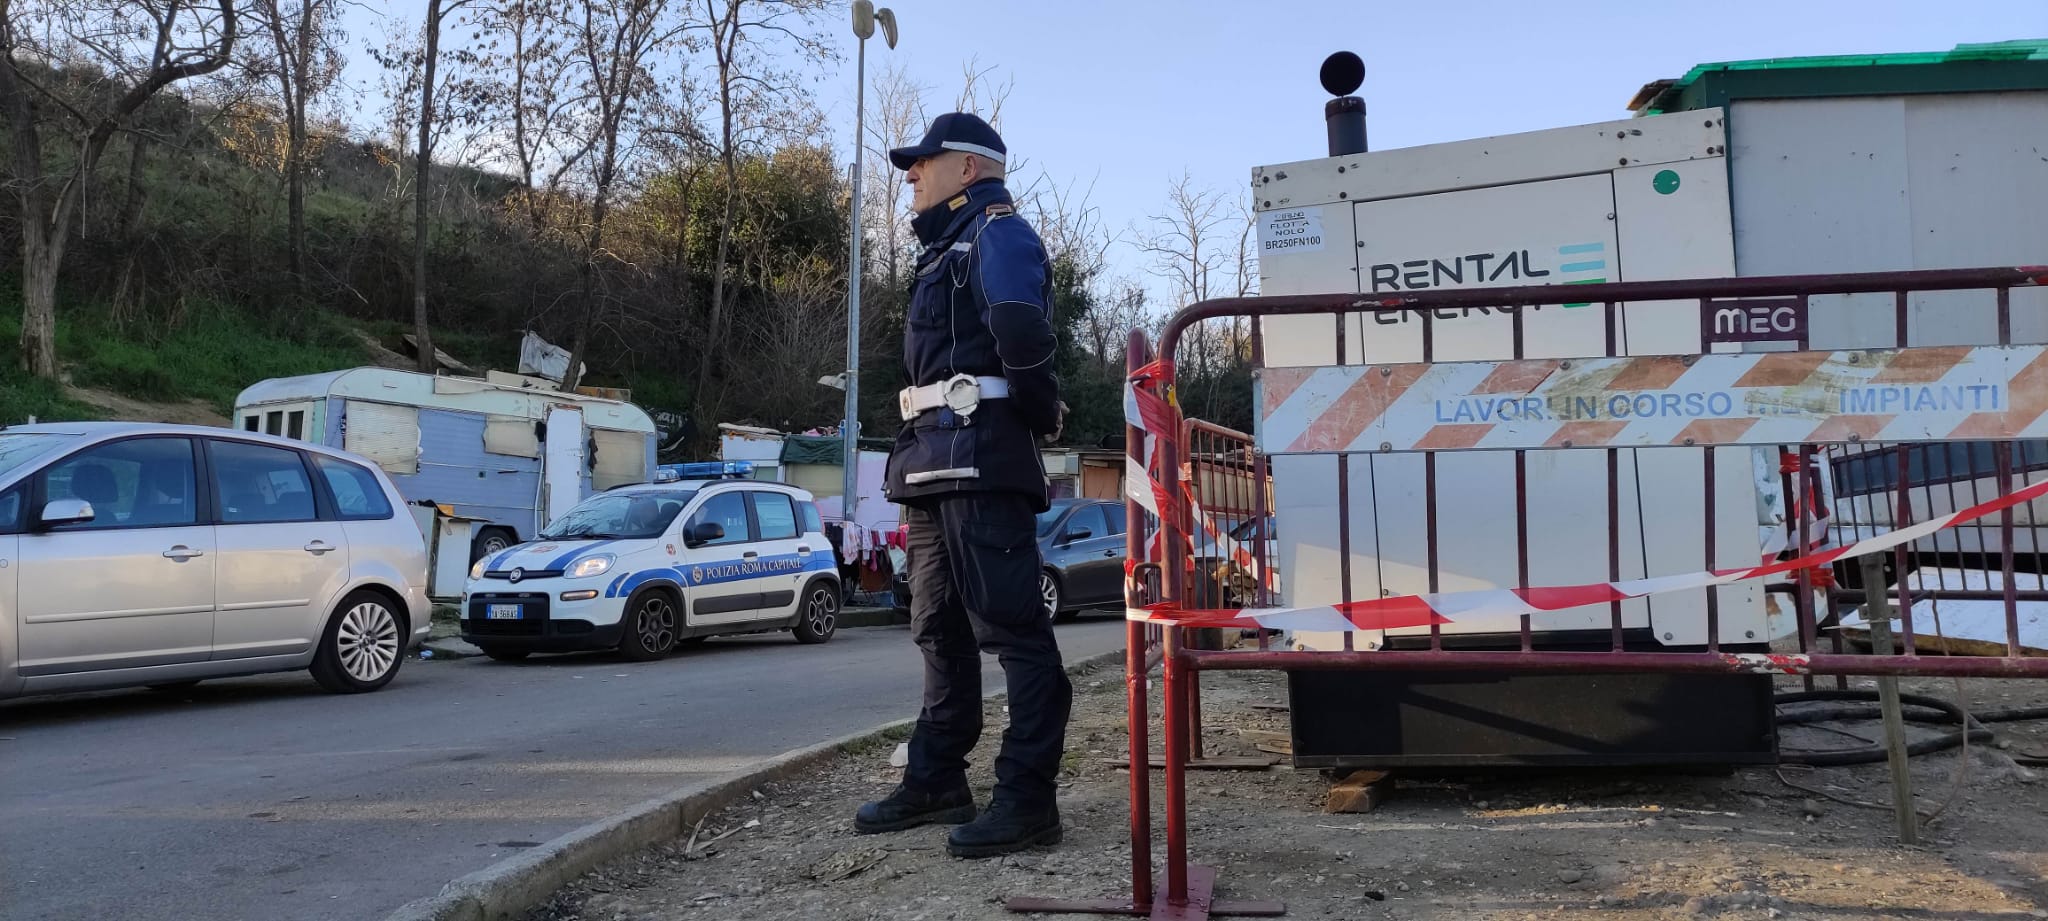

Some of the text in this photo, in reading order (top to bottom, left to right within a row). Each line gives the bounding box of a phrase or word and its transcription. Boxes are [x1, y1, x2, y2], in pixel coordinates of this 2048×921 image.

[1270, 220, 1310, 230] FLOTA
[1275, 228, 1305, 236] NOLO
[1265, 236, 1321, 250] BR250FN100
[1371, 250, 1550, 292] RENTAL
[1715, 306, 1796, 335] MEG
[1565, 395, 1598, 420] IN
[1608, 391, 1733, 419] CORSO
[1839, 384, 1999, 414] IMPIANTI
[706, 558, 802, 580] POLIZIA ROMA CAPITALE
